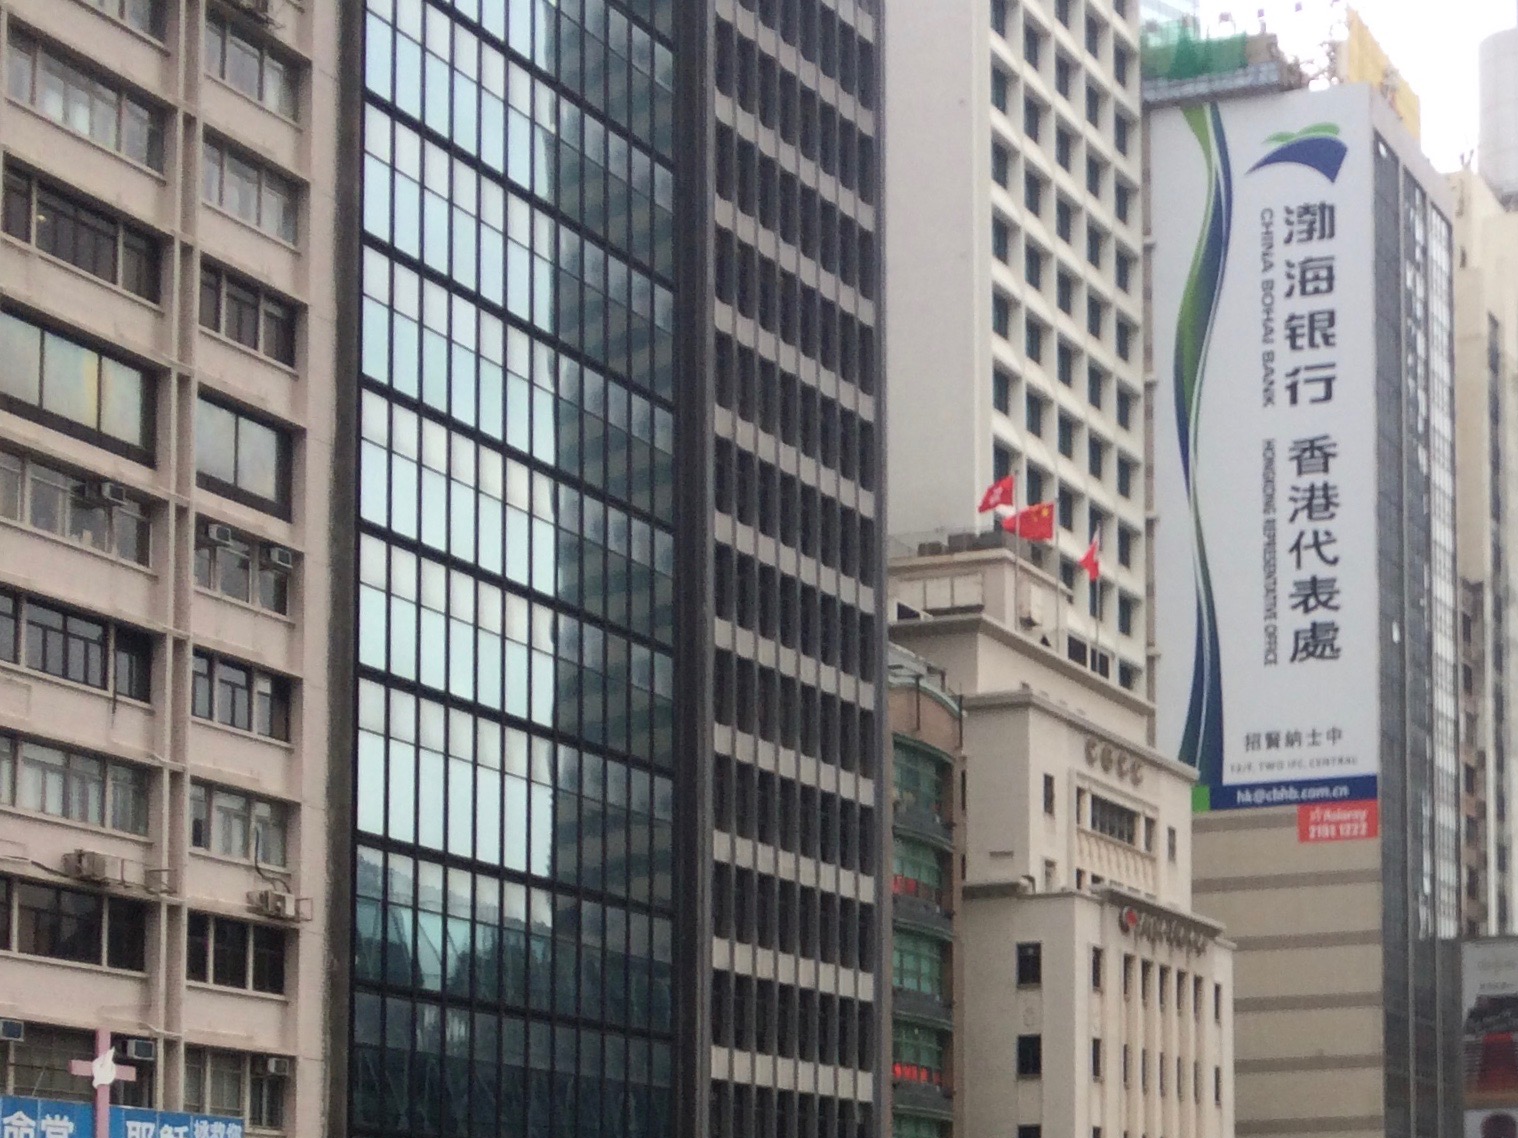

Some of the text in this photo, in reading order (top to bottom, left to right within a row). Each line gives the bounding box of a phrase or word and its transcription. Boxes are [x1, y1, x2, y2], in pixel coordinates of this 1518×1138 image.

[1260, 207, 1276, 408] CHINA BOHAI BANK
[1283, 200, 1342, 665] 渤海银行 香港代表處
